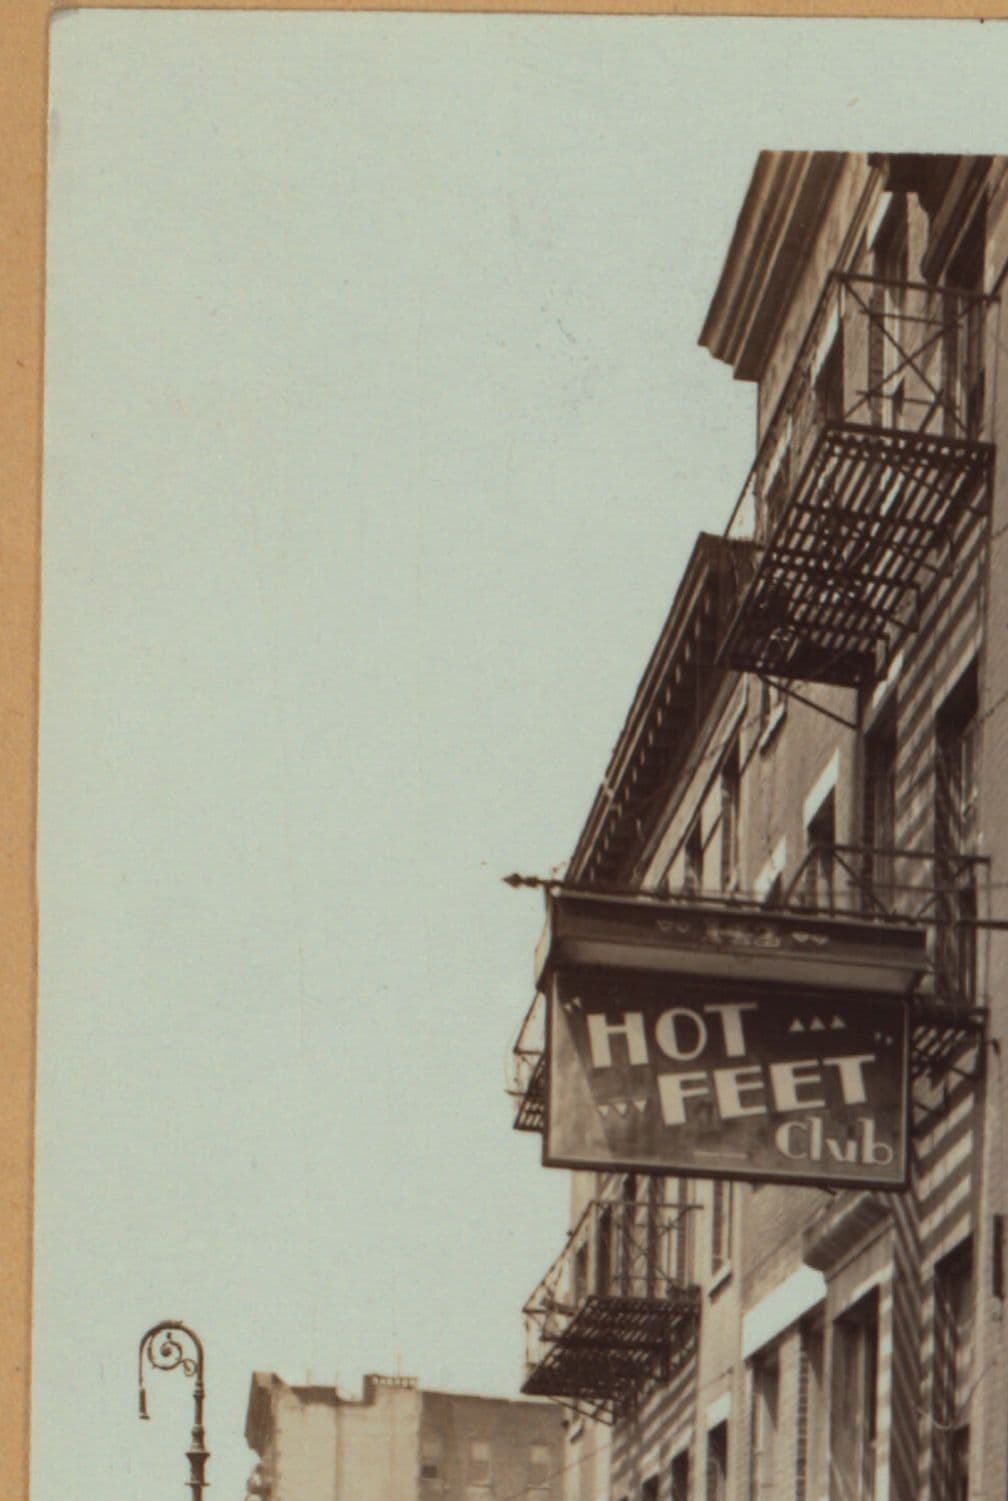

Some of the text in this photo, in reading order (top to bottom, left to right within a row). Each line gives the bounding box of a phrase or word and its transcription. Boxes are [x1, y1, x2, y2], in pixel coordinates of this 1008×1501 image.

[586, 1002, 758, 1068] HOT
[657, 1054, 877, 1126] FEET
[774, 1116, 894, 1166] Club
